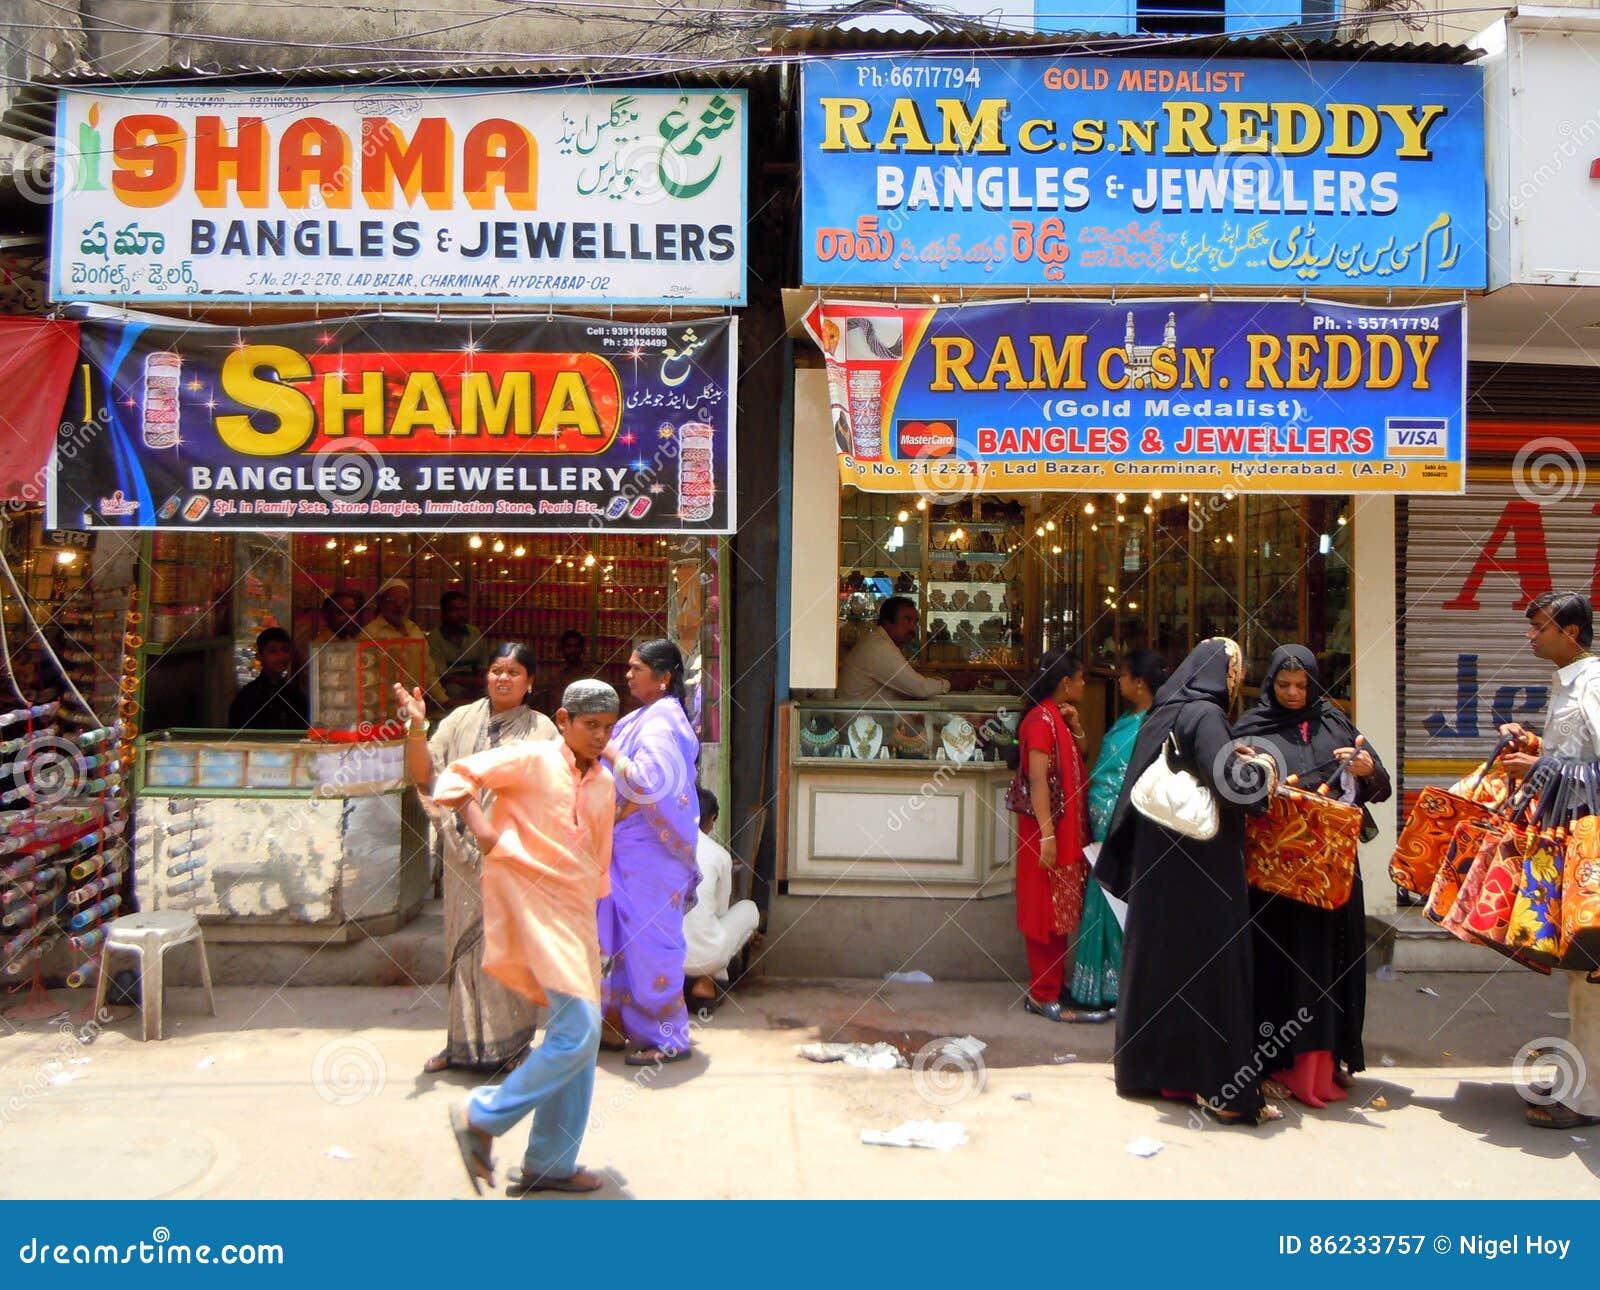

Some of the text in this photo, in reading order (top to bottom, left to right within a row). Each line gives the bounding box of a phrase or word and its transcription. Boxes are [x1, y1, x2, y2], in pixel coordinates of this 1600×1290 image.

[1044, 68, 1245, 93] GOLD MEDALIST
[819, 98, 1009, 152] RAM
[1162, 101, 1446, 158] REDDY
[112, 114, 537, 210] SHAMA
[877, 166, 1090, 209] BANGLES
[1132, 168, 1399, 213] JEWELLERS
[190, 219, 421, 256] BANGLES
[460, 221, 735, 261] JEWELLERS
[508, 275, 611, 290] HYDERABAD-02
[586, 327, 604, 336] Cell
[611, 327, 668, 337] 9391106598
[1313, 316, 1341, 330] Ph.
[1358, 317, 1440, 331] 55717794
[603, 338, 615, 347] Ph
[622, 338, 668, 348] 32424499
[929, 334, 1088, 391] RAM
[1246, 334, 1440, 390] REDDY
[215, 344, 602, 457] SHAMA
[1043, 398, 1302, 421] (Gold Medalist)
[900, 434, 954, 445] MasterCard
[977, 428, 1374, 454] BANGLES & JEWELLERS
[1396, 430, 1438, 446] VISA
[191, 466, 628, 491] BANGLES & JEWELLERY
[873, 463, 902, 475] No.
[1004, 462, 1037, 474] Lad
[1046, 462, 1104, 476] Bazar,
[1114, 462, 1222, 476] Charminar,
[1230, 463, 1343, 478] Hyderabad.
[1352, 463, 1407, 478] (A.P.)
[213, 500, 237, 516] Spl.
[239, 500, 252, 513] in
[254, 500, 296, 517] Family
[299, 500, 330, 515] Sets,
[332, 501, 369, 514] Stone
[370, 501, 422, 517] Bangles,
[424, 501, 494, 514] Immitation
[496, 501, 536, 515] Stone,
[539, 501, 573, 514] Pearls
